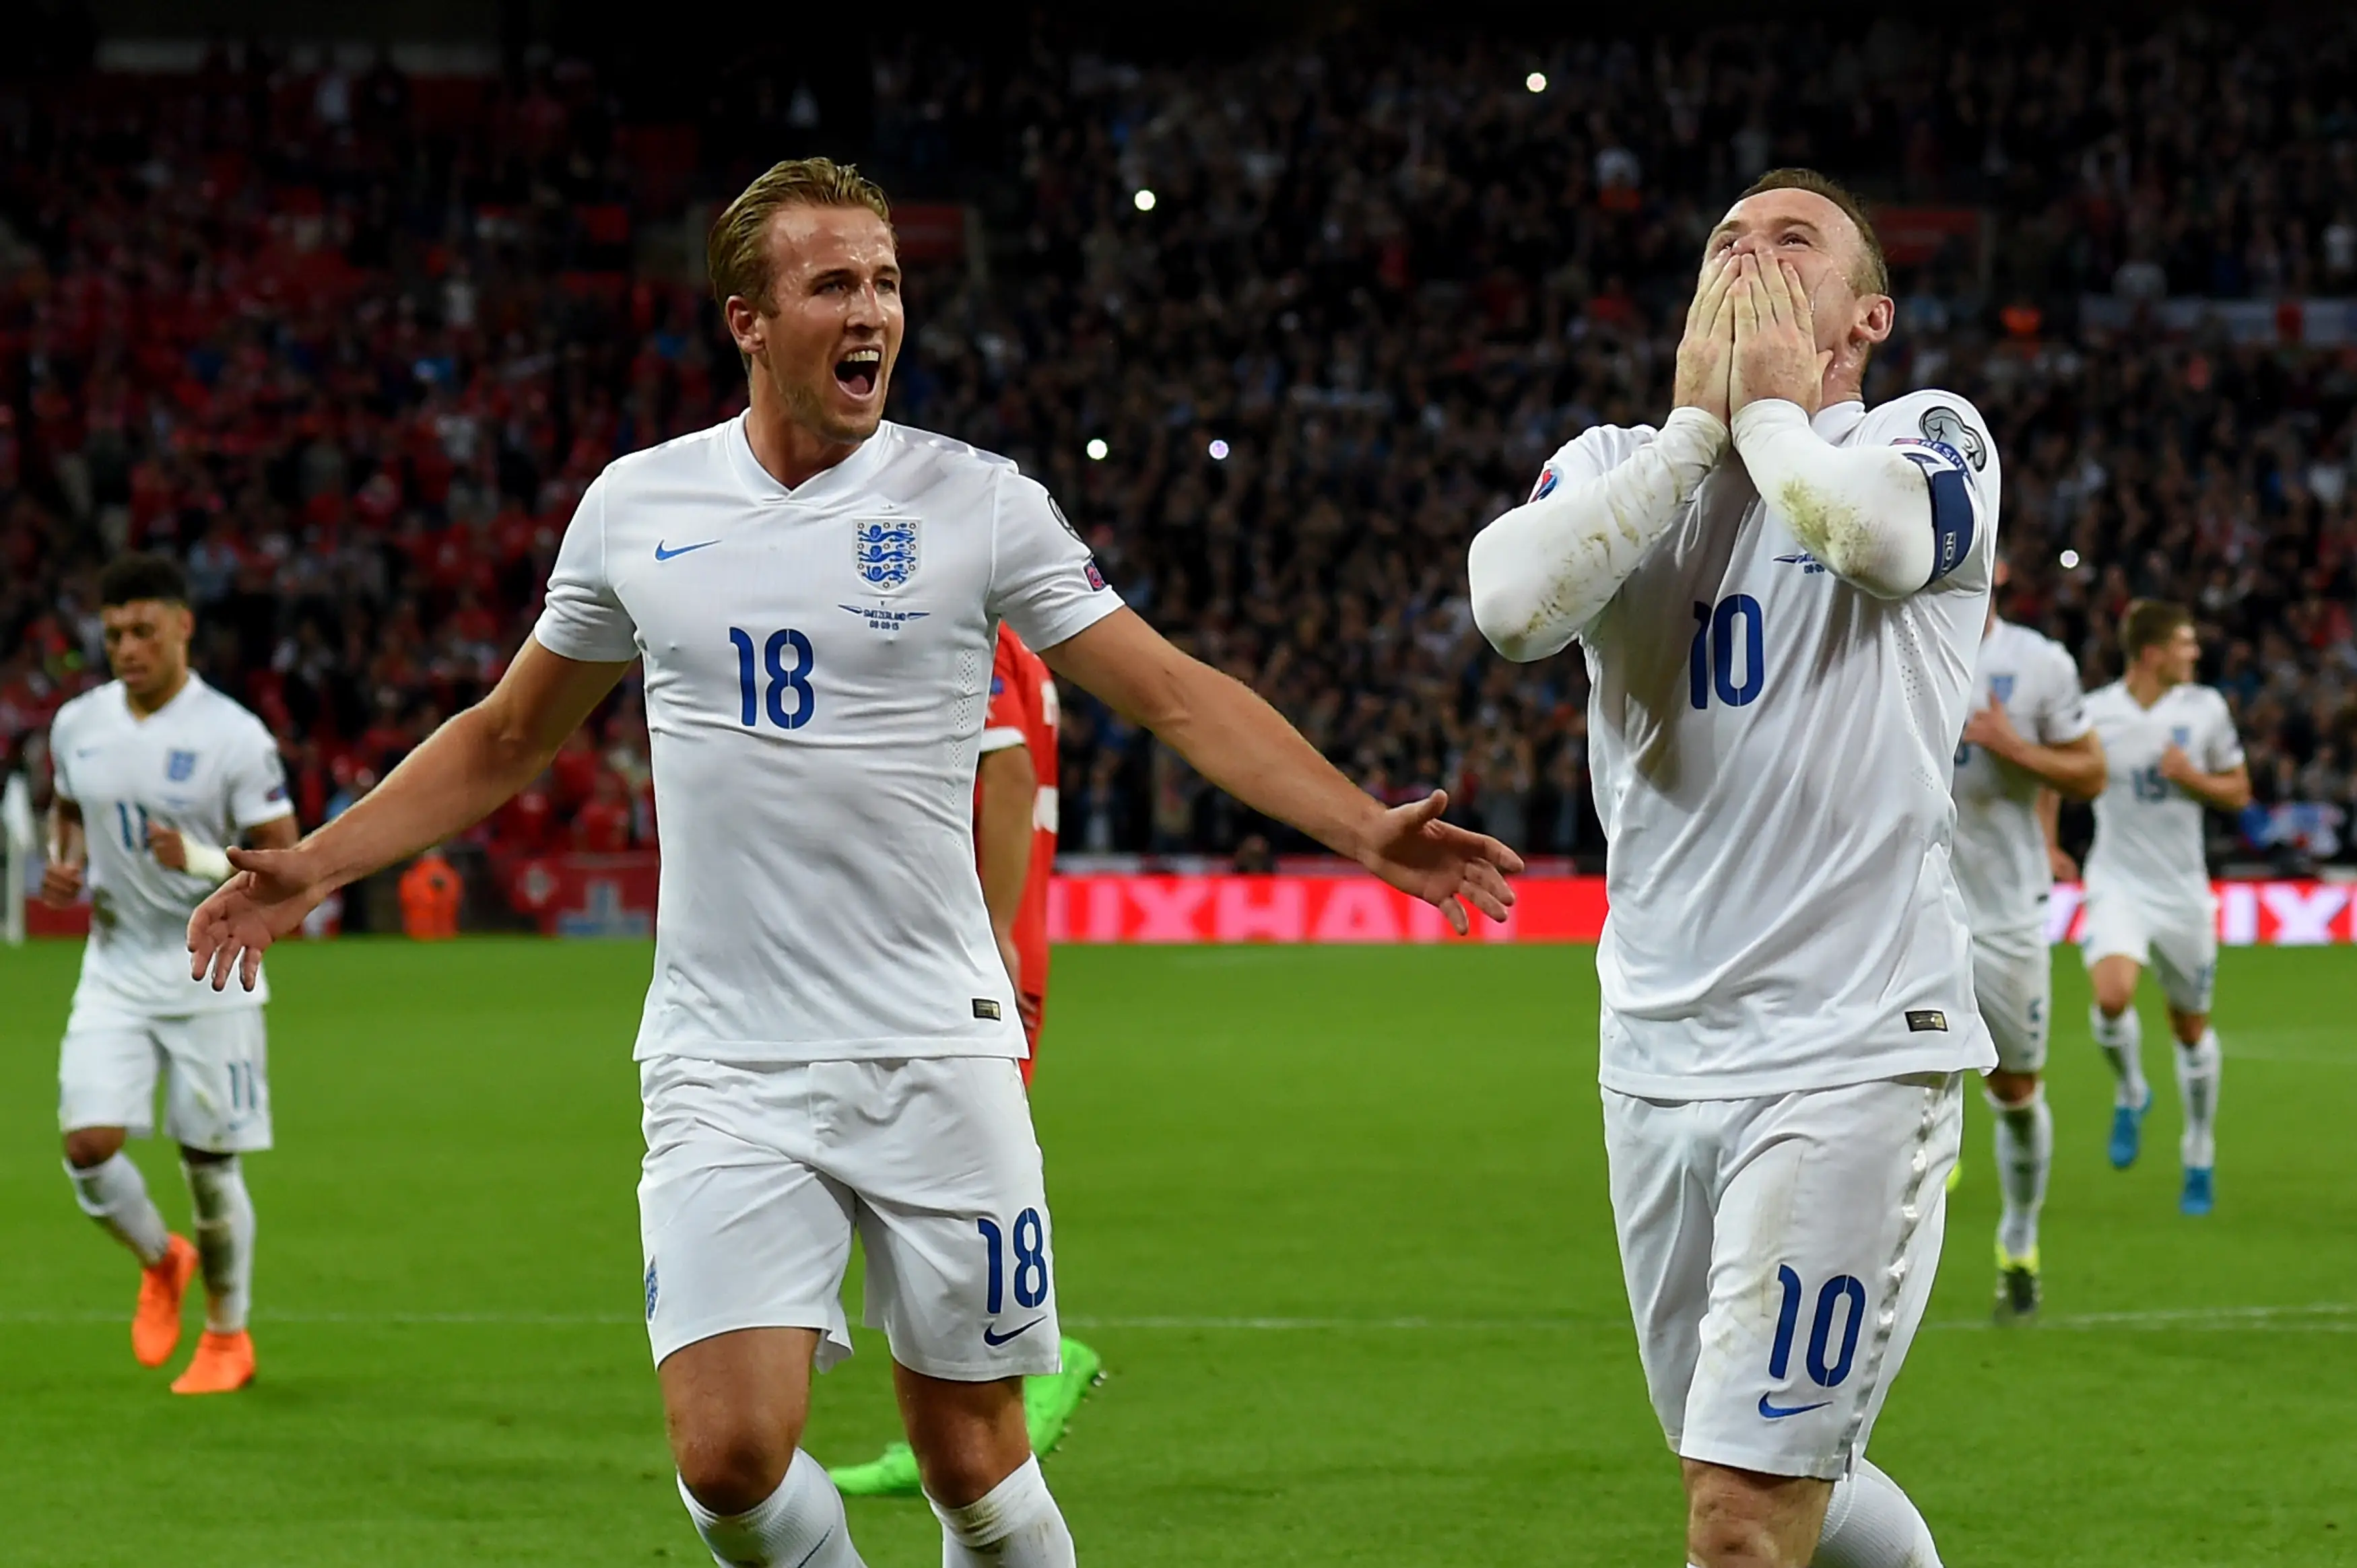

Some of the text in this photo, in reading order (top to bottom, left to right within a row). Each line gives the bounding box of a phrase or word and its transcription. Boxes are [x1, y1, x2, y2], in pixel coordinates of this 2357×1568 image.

[729, 626, 815, 730] 18
[1690, 594, 1764, 710] 10
[117, 801, 151, 851] 11
[2130, 765, 2168, 805] 15
[227, 1060, 258, 1111] 11
[978, 1207, 1048, 1315] 18
[1768, 1264, 1866, 1388] 10
